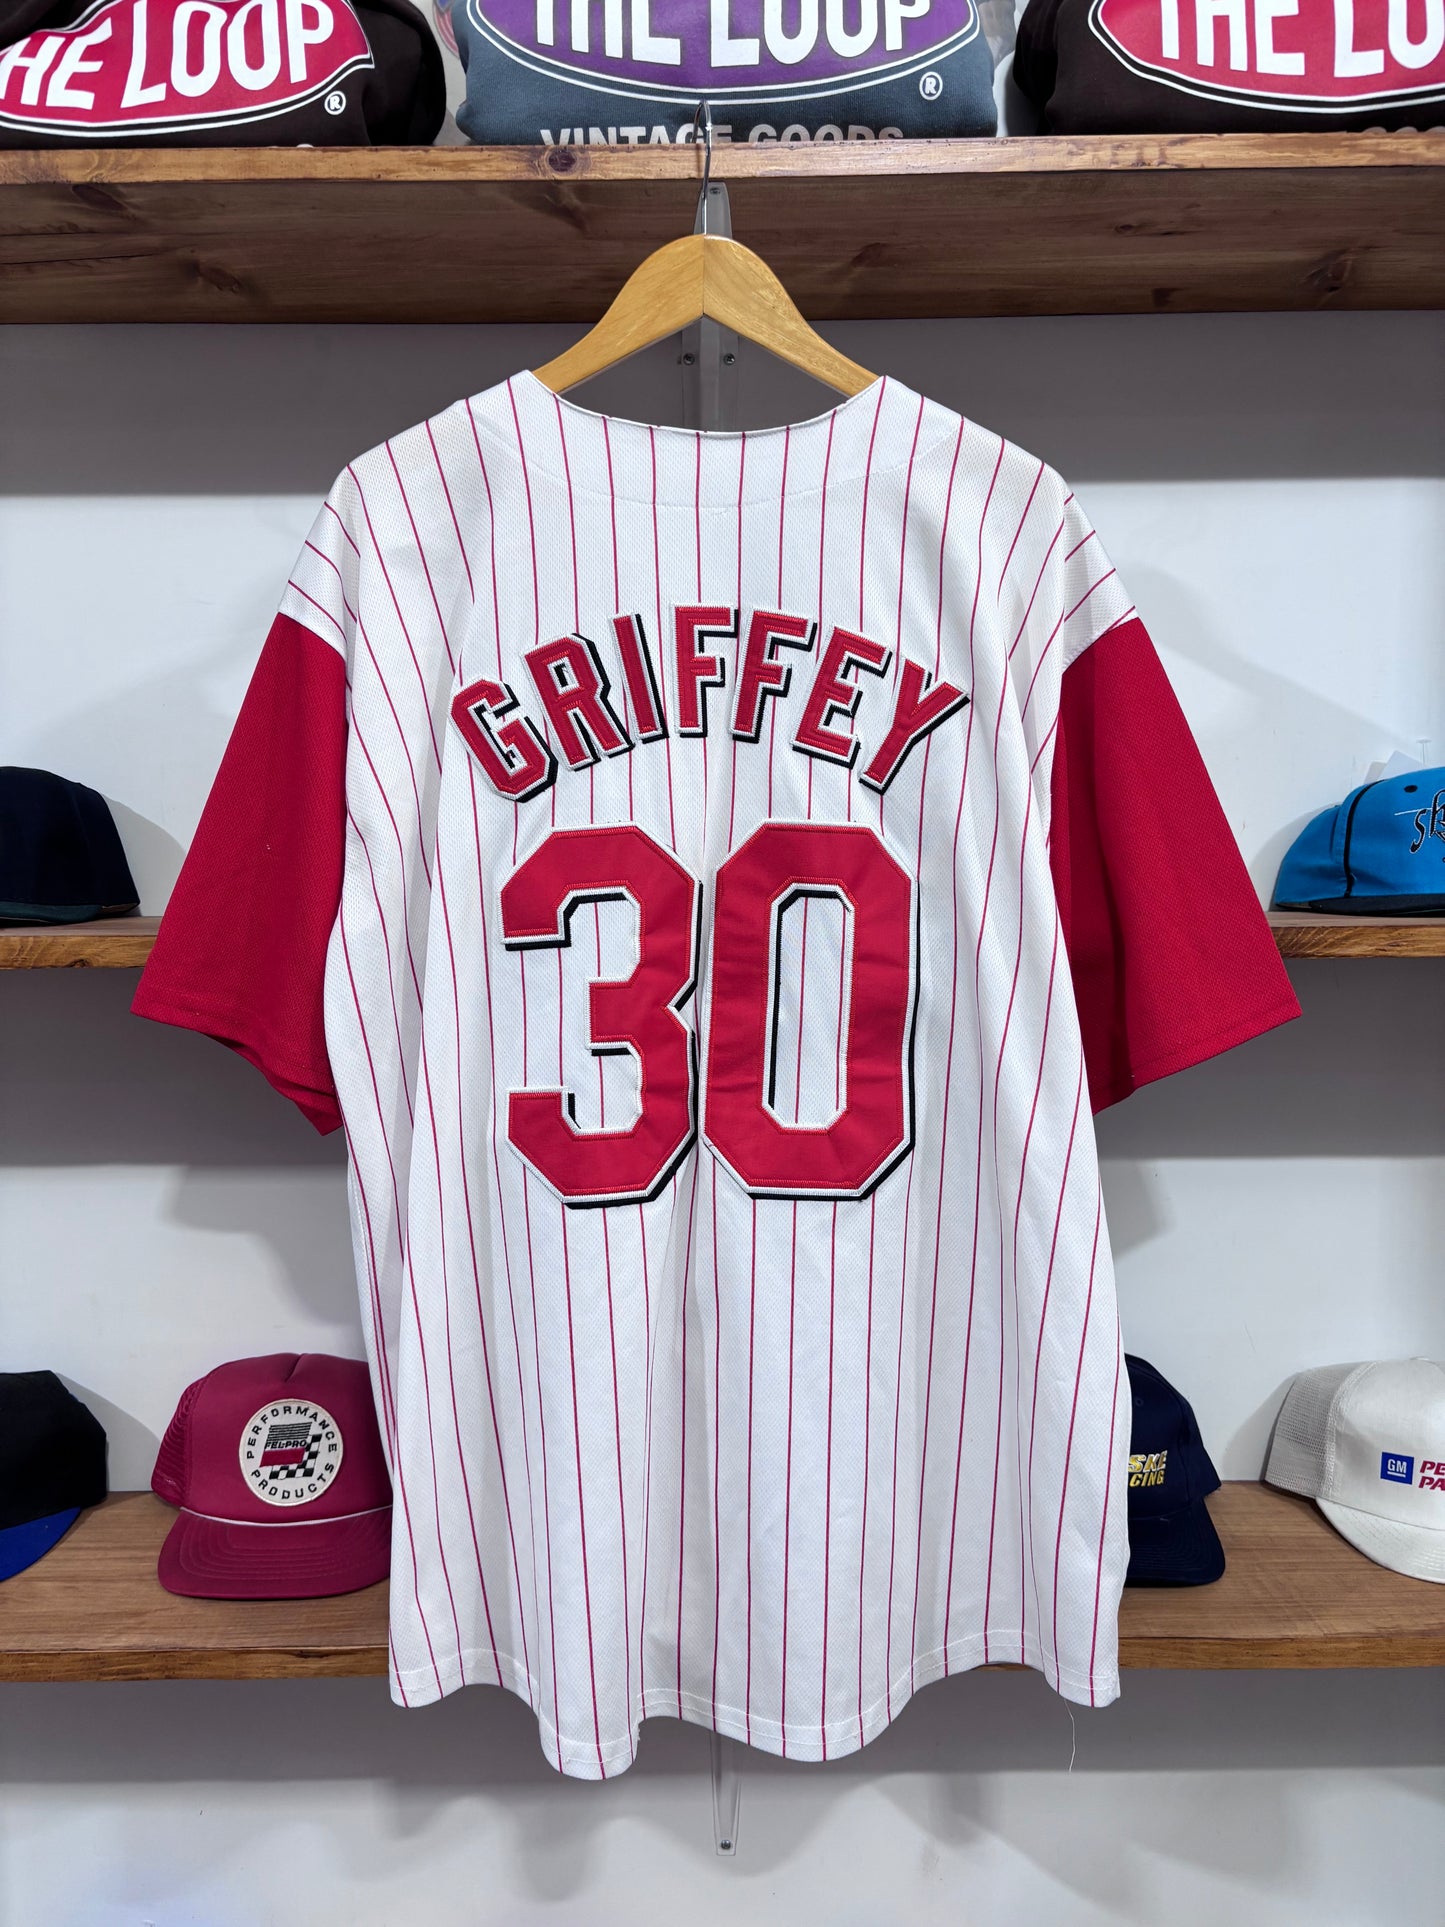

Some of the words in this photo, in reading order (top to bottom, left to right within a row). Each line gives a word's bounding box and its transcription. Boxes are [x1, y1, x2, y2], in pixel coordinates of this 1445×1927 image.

[120, 0, 334, 108] LOOP
[450, 602, 971, 803] GRIFFEY
[497, 817, 920, 1210] 30
[246, 1405, 338, 1460] PERFORMANCE
[1387, 1458, 1408, 1474] GM
[251, 1462, 335, 1500] PRODUCTS
